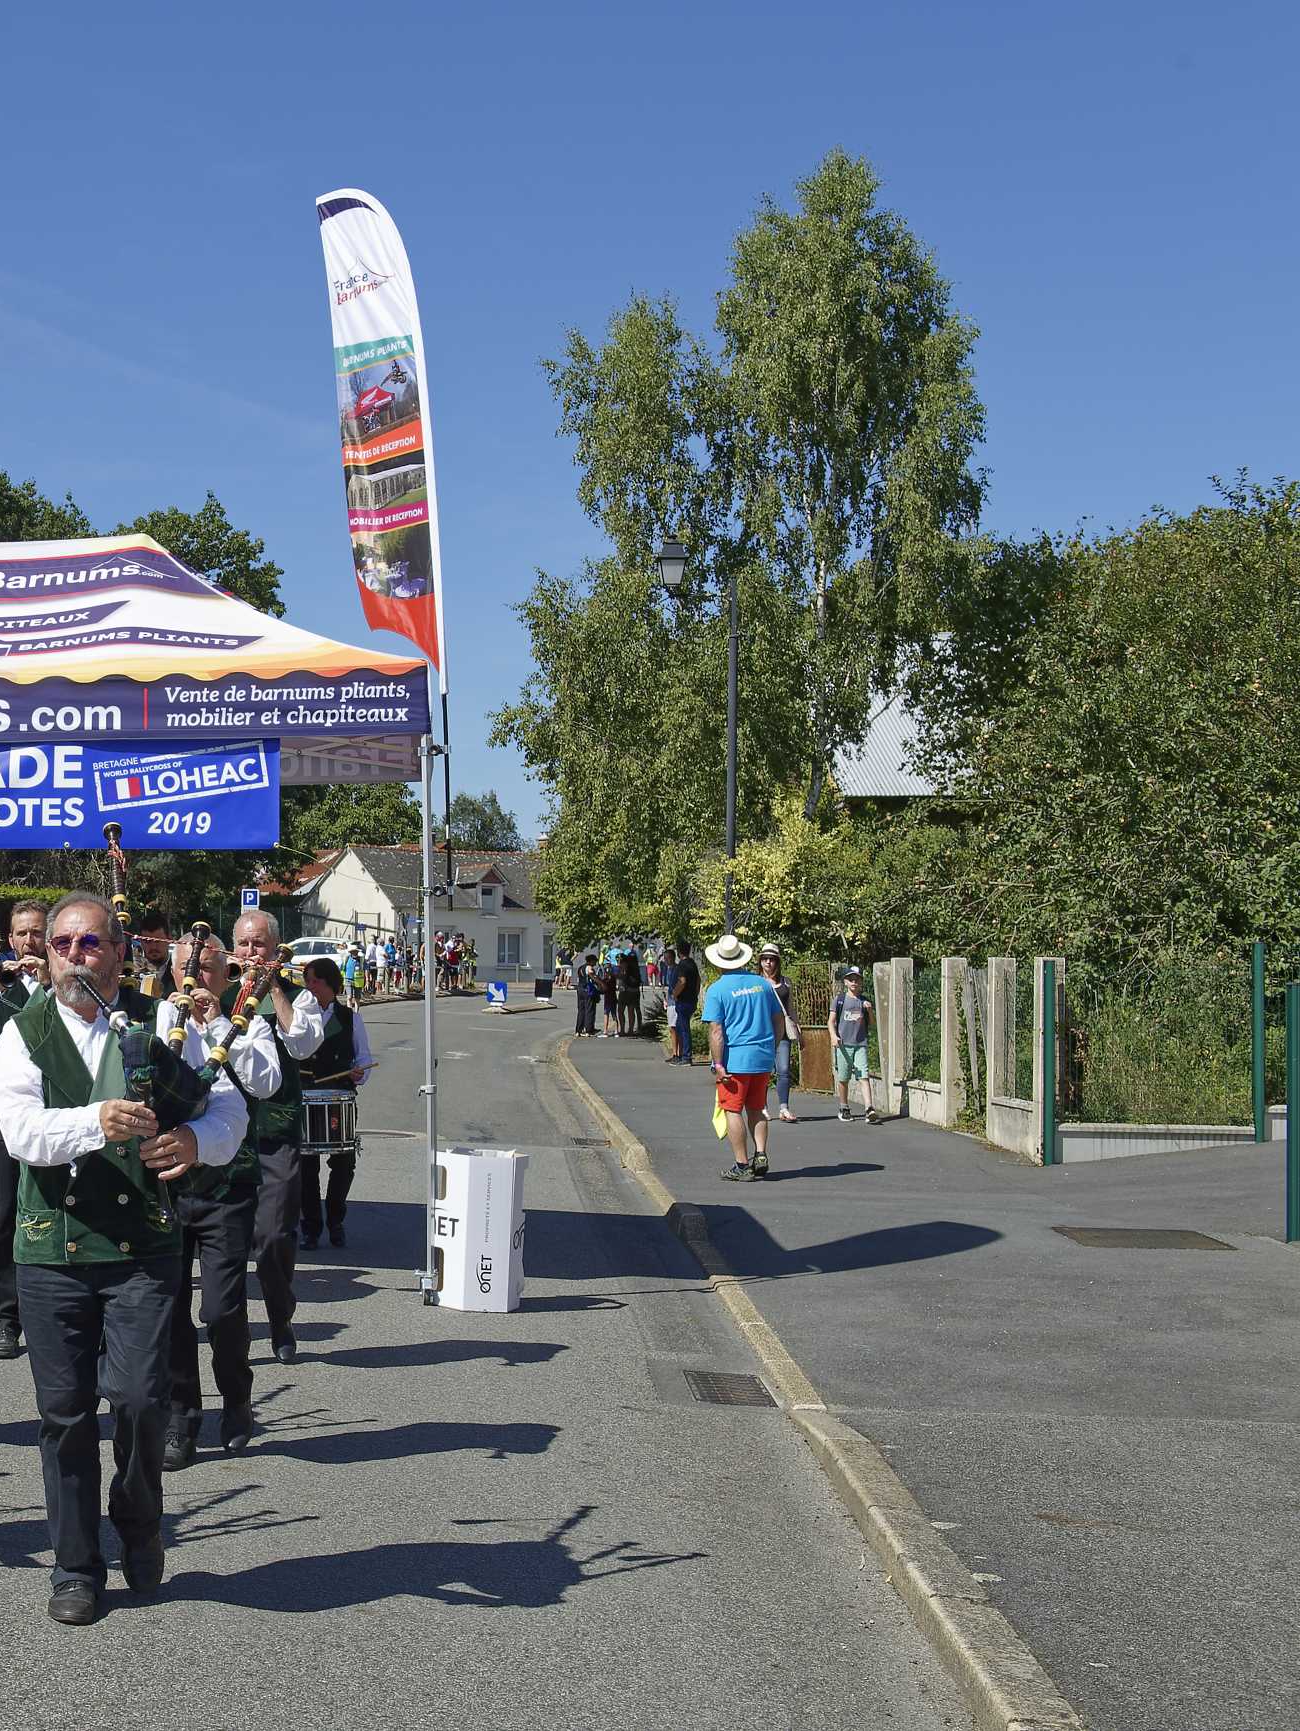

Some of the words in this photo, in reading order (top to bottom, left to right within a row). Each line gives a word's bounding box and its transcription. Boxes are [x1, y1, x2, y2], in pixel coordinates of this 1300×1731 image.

[18, 631, 131, 651] BARNUMS
[138, 631, 238, 645] PLIANTS
[165, 686, 219, 703] Vente
[224, 685, 246, 701] de
[250, 684, 335, 701] barnums
[340, 682, 411, 703] pliants,
[167, 707, 254, 726] mobilier
[260, 709, 281, 725] et
[286, 704, 409, 727] chapiteaux
[92, 757, 139, 770] BRETAGNE
[103, 769, 129, 778] WORLD
[129, 762, 172, 774] RALLYCROSS
[143, 758, 259, 796] LOHEAC
[148, 811, 212, 835] 2019
[246, 892, 254, 904] P
